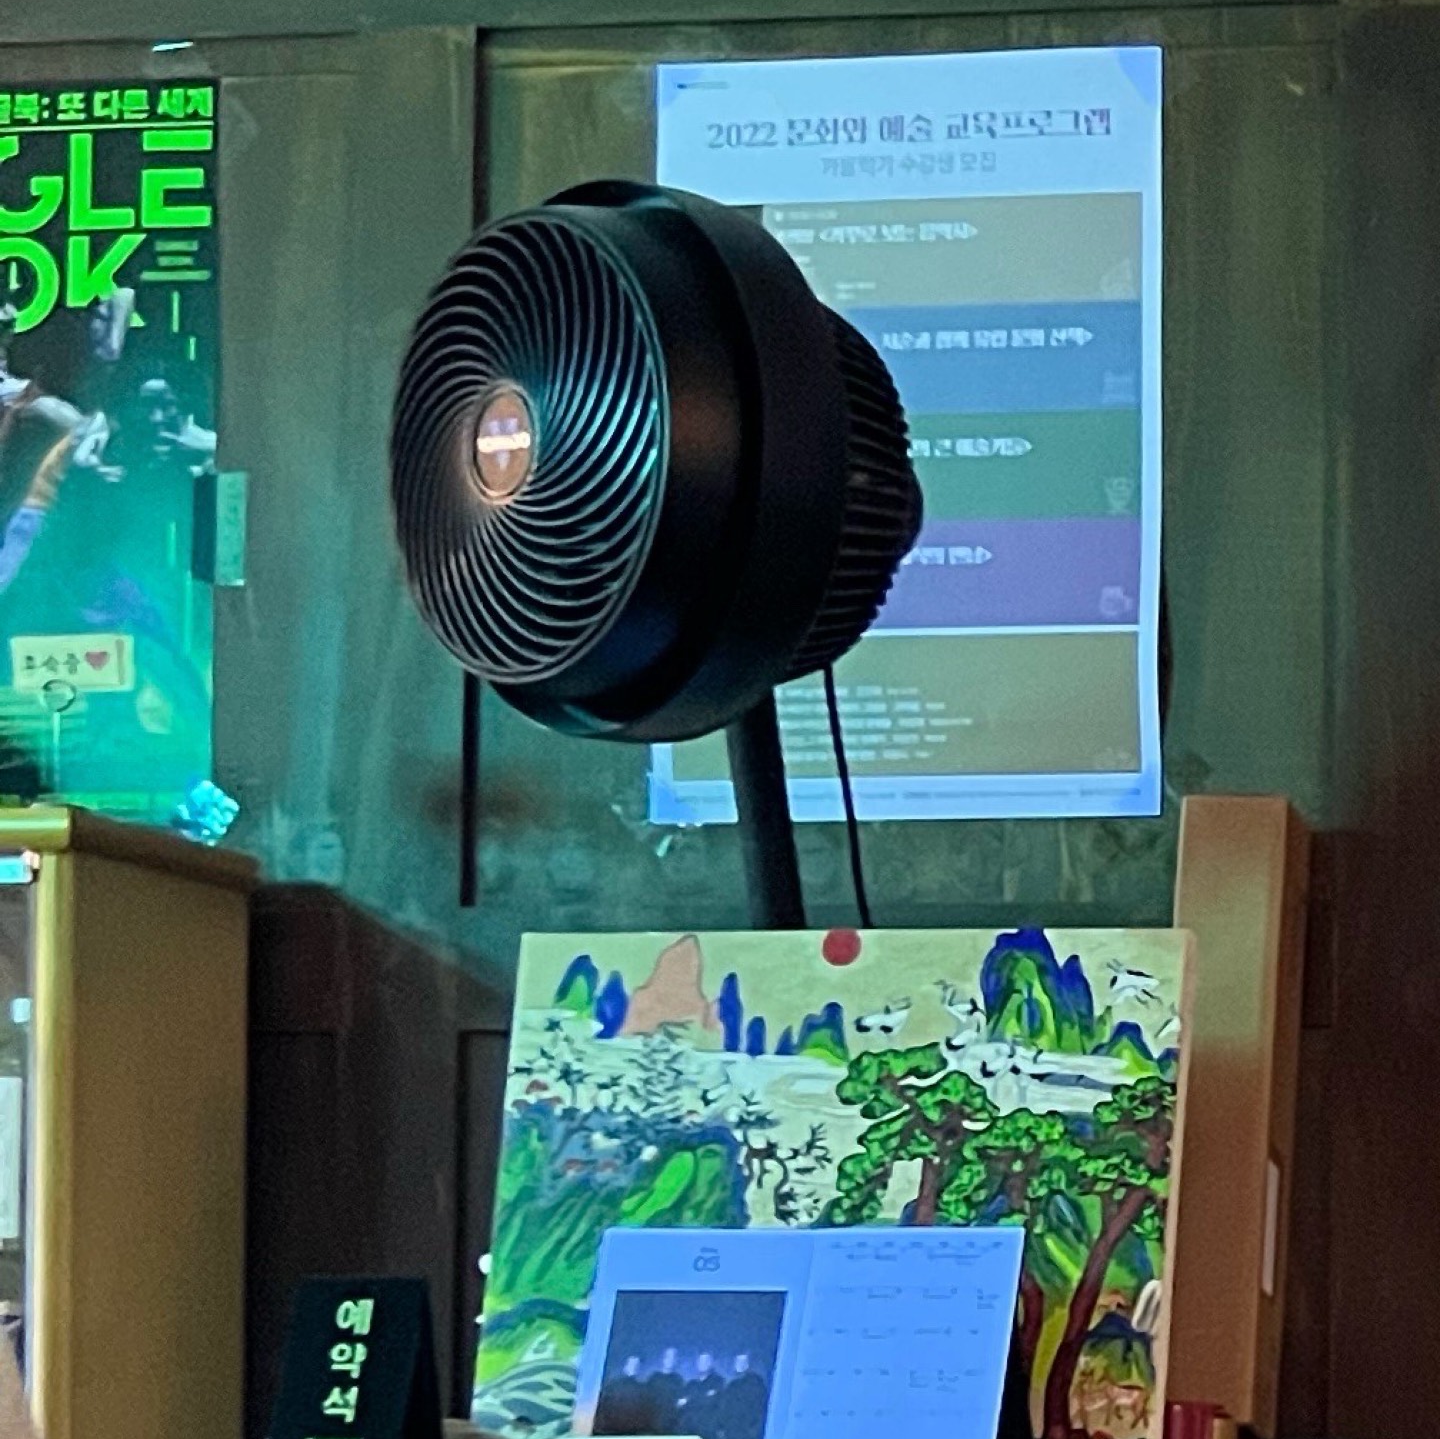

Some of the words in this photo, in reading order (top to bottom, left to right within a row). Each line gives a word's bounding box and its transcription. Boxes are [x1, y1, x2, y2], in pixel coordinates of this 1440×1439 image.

[707, 121, 779, 150] 2022
[878, 113, 934, 143] 예술
[946, 108, 1112, 140] 교육프로그램
[321, 1297, 376, 1424] 예약석
